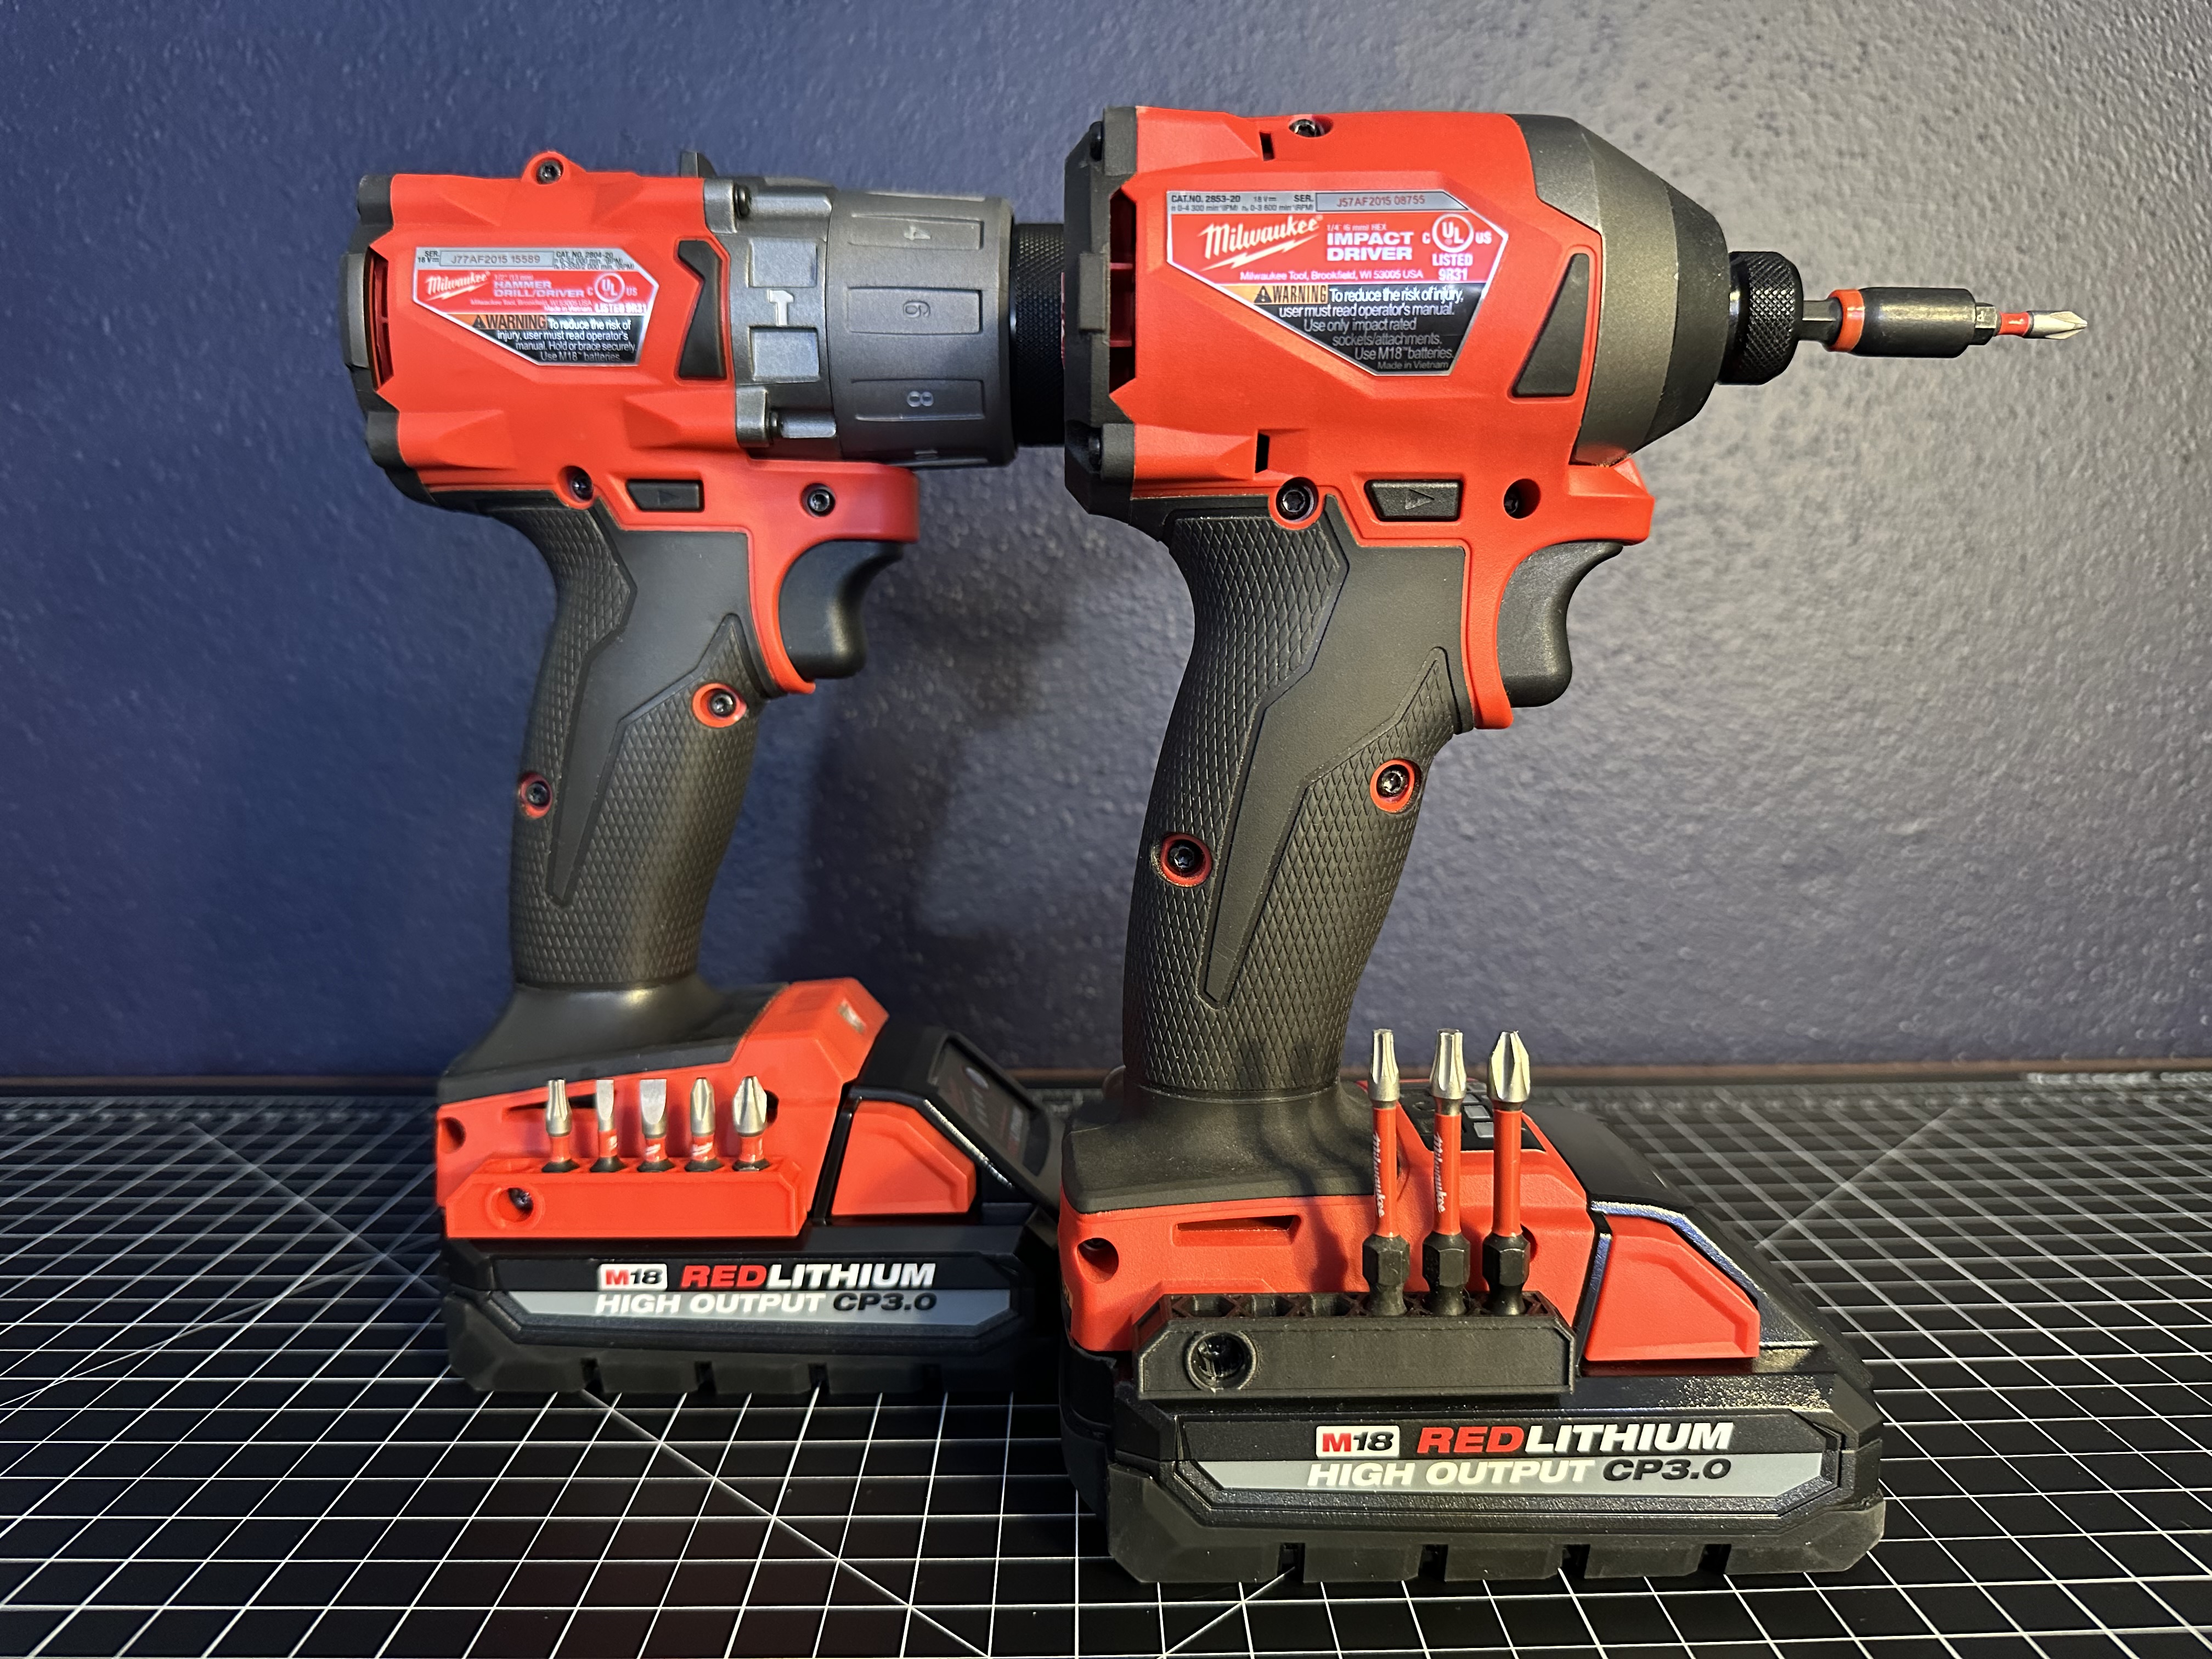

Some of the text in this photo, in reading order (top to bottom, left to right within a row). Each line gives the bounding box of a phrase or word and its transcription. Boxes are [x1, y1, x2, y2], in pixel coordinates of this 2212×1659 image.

[1197, 215, 1320, 259] Milwaukee
[1327, 232, 1414, 245] IMPACT
[1475, 232, 1492, 244] US
[451, 255, 507, 263] J77AF2015
[1327, 247, 1413, 261] DRIVER
[1432, 253, 1473, 267] LISTED
[1240, 272, 1287, 280] Milwaukee
[1289, 271, 1309, 281] Tool,
[1311, 270, 1358, 280] Brookfield,
[1359, 271, 1372, 279] WI
[1402, 270, 1424, 279] USA
[425, 272, 487, 295] Milwaukee
[494, 280, 552, 289] HAMMER
[494, 290, 585, 298] DRILL/DRIVER
[626, 287, 638, 297] US
[1272, 285, 1327, 304] WARNING
[1329, 288, 1342, 302] To
[1344, 289, 1381, 302] reduce
[1383, 287, 1400, 302] the
[1402, 288, 1420, 301] risk
[1421, 287, 1434, 301] of
[595, 303, 625, 313] LISTED
[1279, 303, 1454, 319] user must read operator's manual.
[486, 315, 547, 329] WARNING
[549, 319, 631, 329] To reduce the risk of
[1304, 318, 1417, 333] Use only impact rated
[498, 331, 522, 341] injury,
[544, 331, 566, 340] must
[567, 331, 585, 340] read
[586, 331, 628, 341] operator's
[1332, 333, 1442, 347] sockets/attachments.
[516, 342, 547, 351] manual.
[549, 341, 567, 351] Hold
[578, 341, 601, 351] brace
[602, 342, 636, 352] securely.
[1355, 348, 1376, 360] Use
[1408, 347, 1454, 359] batteries.
[540, 352, 558, 361] Use
[1378, 362, 1402, 370] Made
[1413, 360, 1449, 369] Vietnam
[907, 391, 934, 408] 8
[605, 1263, 936, 1289] M18 REDLITHIUM
[596, 1292, 937, 1313] HIGH OUTPUT CP3.0
[1322, 1423, 1734, 1453] M18 REDLITHIUM
[1307, 1458, 1731, 1487] HIGH OUTPUT CP3.0
